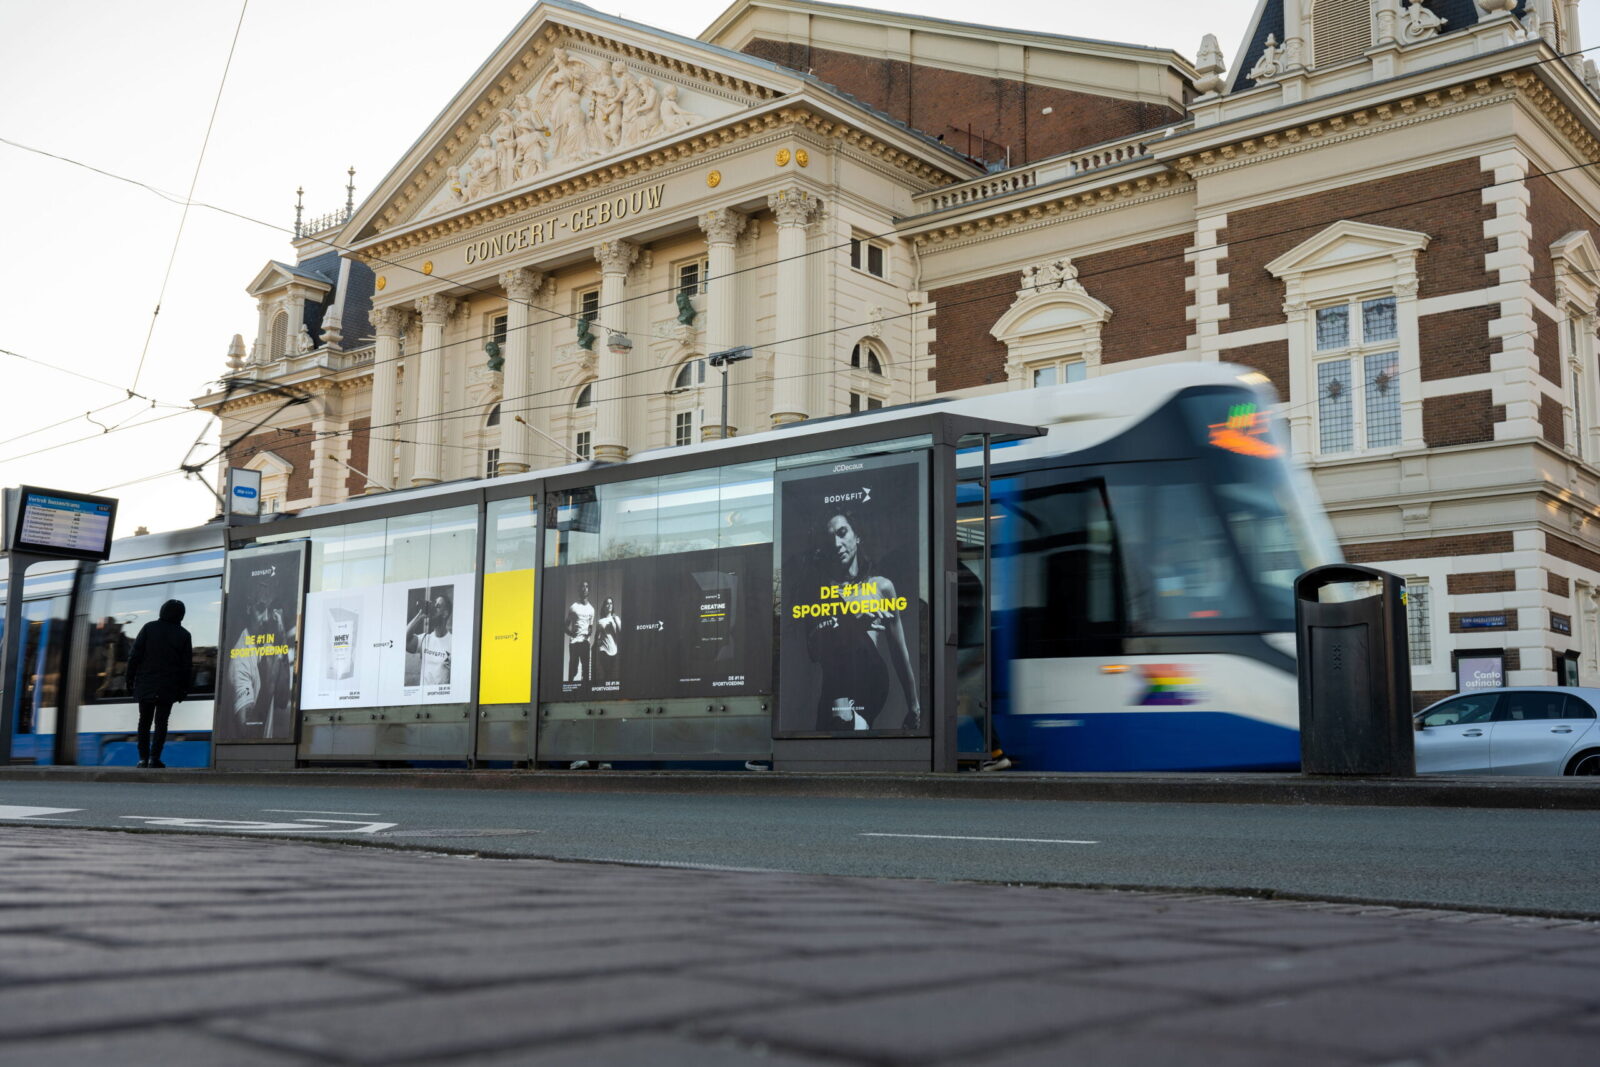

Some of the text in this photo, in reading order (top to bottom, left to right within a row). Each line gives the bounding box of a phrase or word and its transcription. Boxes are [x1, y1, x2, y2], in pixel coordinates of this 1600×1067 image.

[464, 184, 665, 265] CONCERT-GEBOUW
[833, 463, 864, 472] JCDecaux
[824, 492, 863, 504] BODY&FIT
[820, 581, 877, 600] DE #1 IN
[792, 597, 907, 619] SPORTVOEDING
[245, 635, 256, 645] DE
[266, 633, 275, 644] IN
[334, 634, 350, 642] WHEY
[230, 644, 289, 659] SPORTVOEDING
[1473, 671, 1501, 679] Canto
[1465, 679, 1502, 687] ostinato
